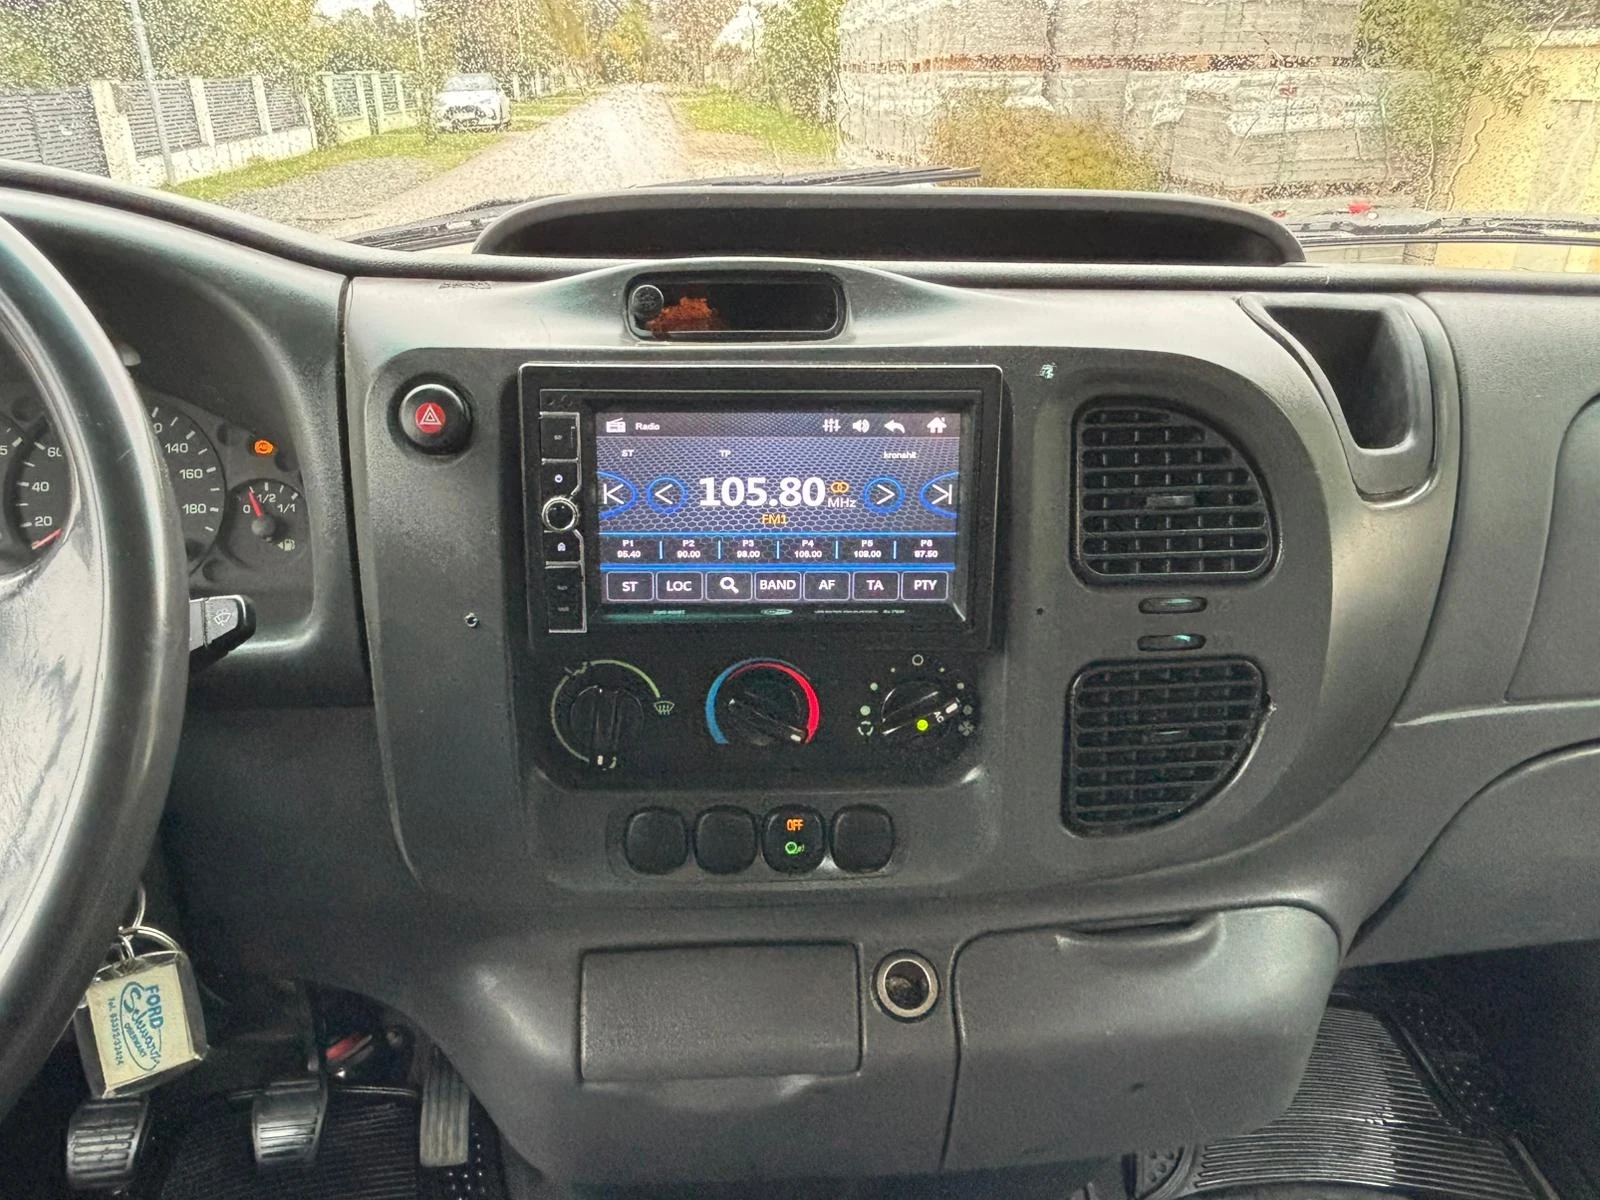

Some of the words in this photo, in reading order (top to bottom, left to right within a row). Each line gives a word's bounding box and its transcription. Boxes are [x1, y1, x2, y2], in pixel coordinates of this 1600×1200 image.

[635, 422, 660, 431] Radio
[165, 443, 188, 453] 140
[621, 449, 635, 458] ST
[720, 449, 731, 458] TP
[180, 469, 203, 479] 160
[31, 482, 50, 492] 40
[700, 476, 826, 507] 105.80
[827, 497, 857, 508] MHz
[257, 493, 276, 503] 1/2
[182, 503, 207, 514] 180
[277, 503, 296, 513] 1/1
[34, 516, 53, 527] 20
[762, 514, 788, 525] FM1
[622, 581, 638, 592] ST
[666, 580, 692, 592] LOC
[759, 579, 797, 591] BAND
[819, 580, 835, 590] AF
[867, 580, 884, 591] TA
[914, 580, 937, 591] PTY
[933, 711, 945, 723] AC
[786, 818, 804, 831] OFF
[145, 984, 164, 1030] FORD
